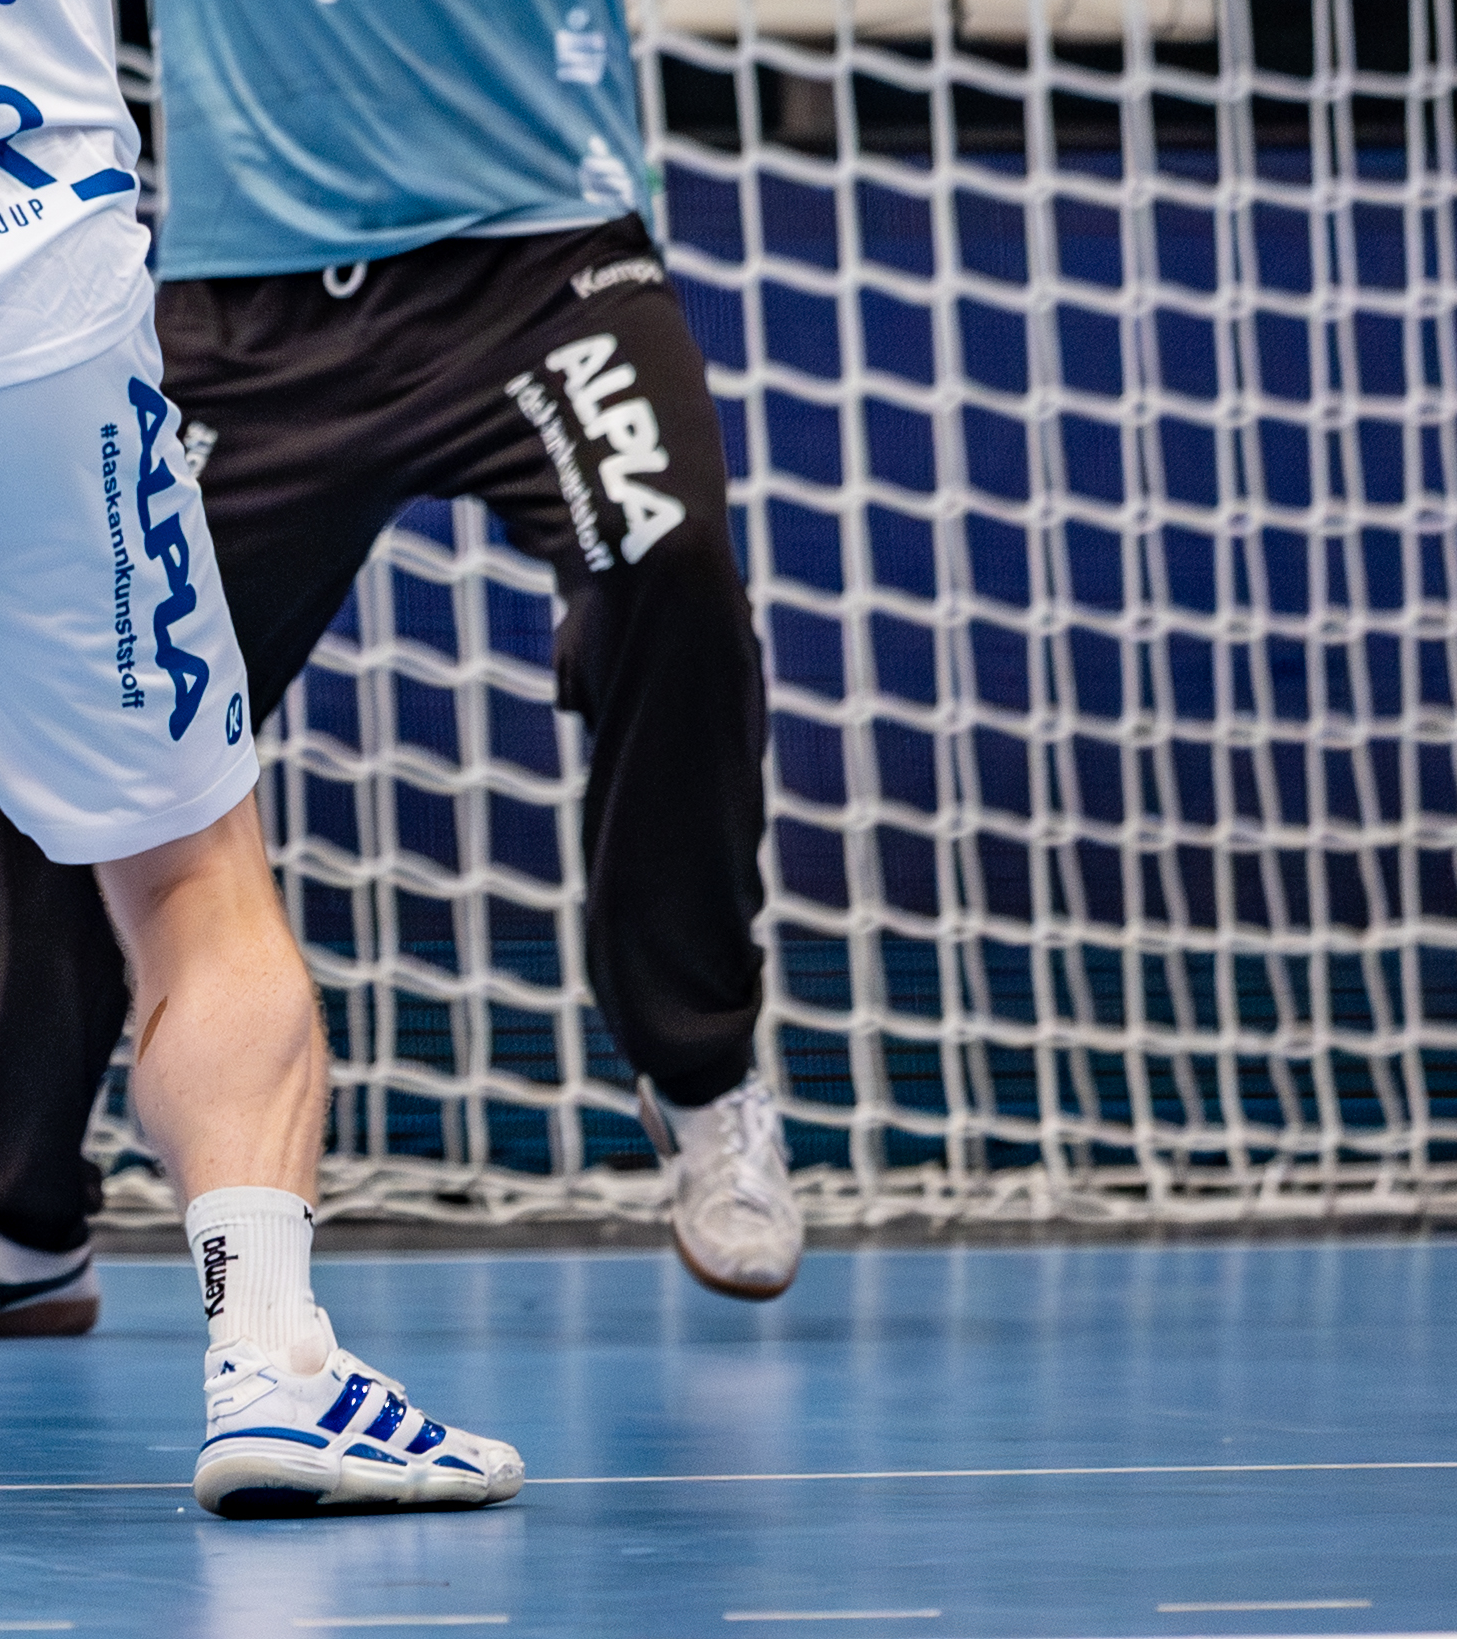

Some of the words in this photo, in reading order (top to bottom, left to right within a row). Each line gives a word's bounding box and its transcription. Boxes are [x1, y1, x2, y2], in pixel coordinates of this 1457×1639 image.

[99, 422, 145, 710] #daskannkunststoff
[127, 375, 210, 742] ALPLA
[545, 332, 686, 565] ALPLA
[202, 1235, 239, 1322] Kempa
